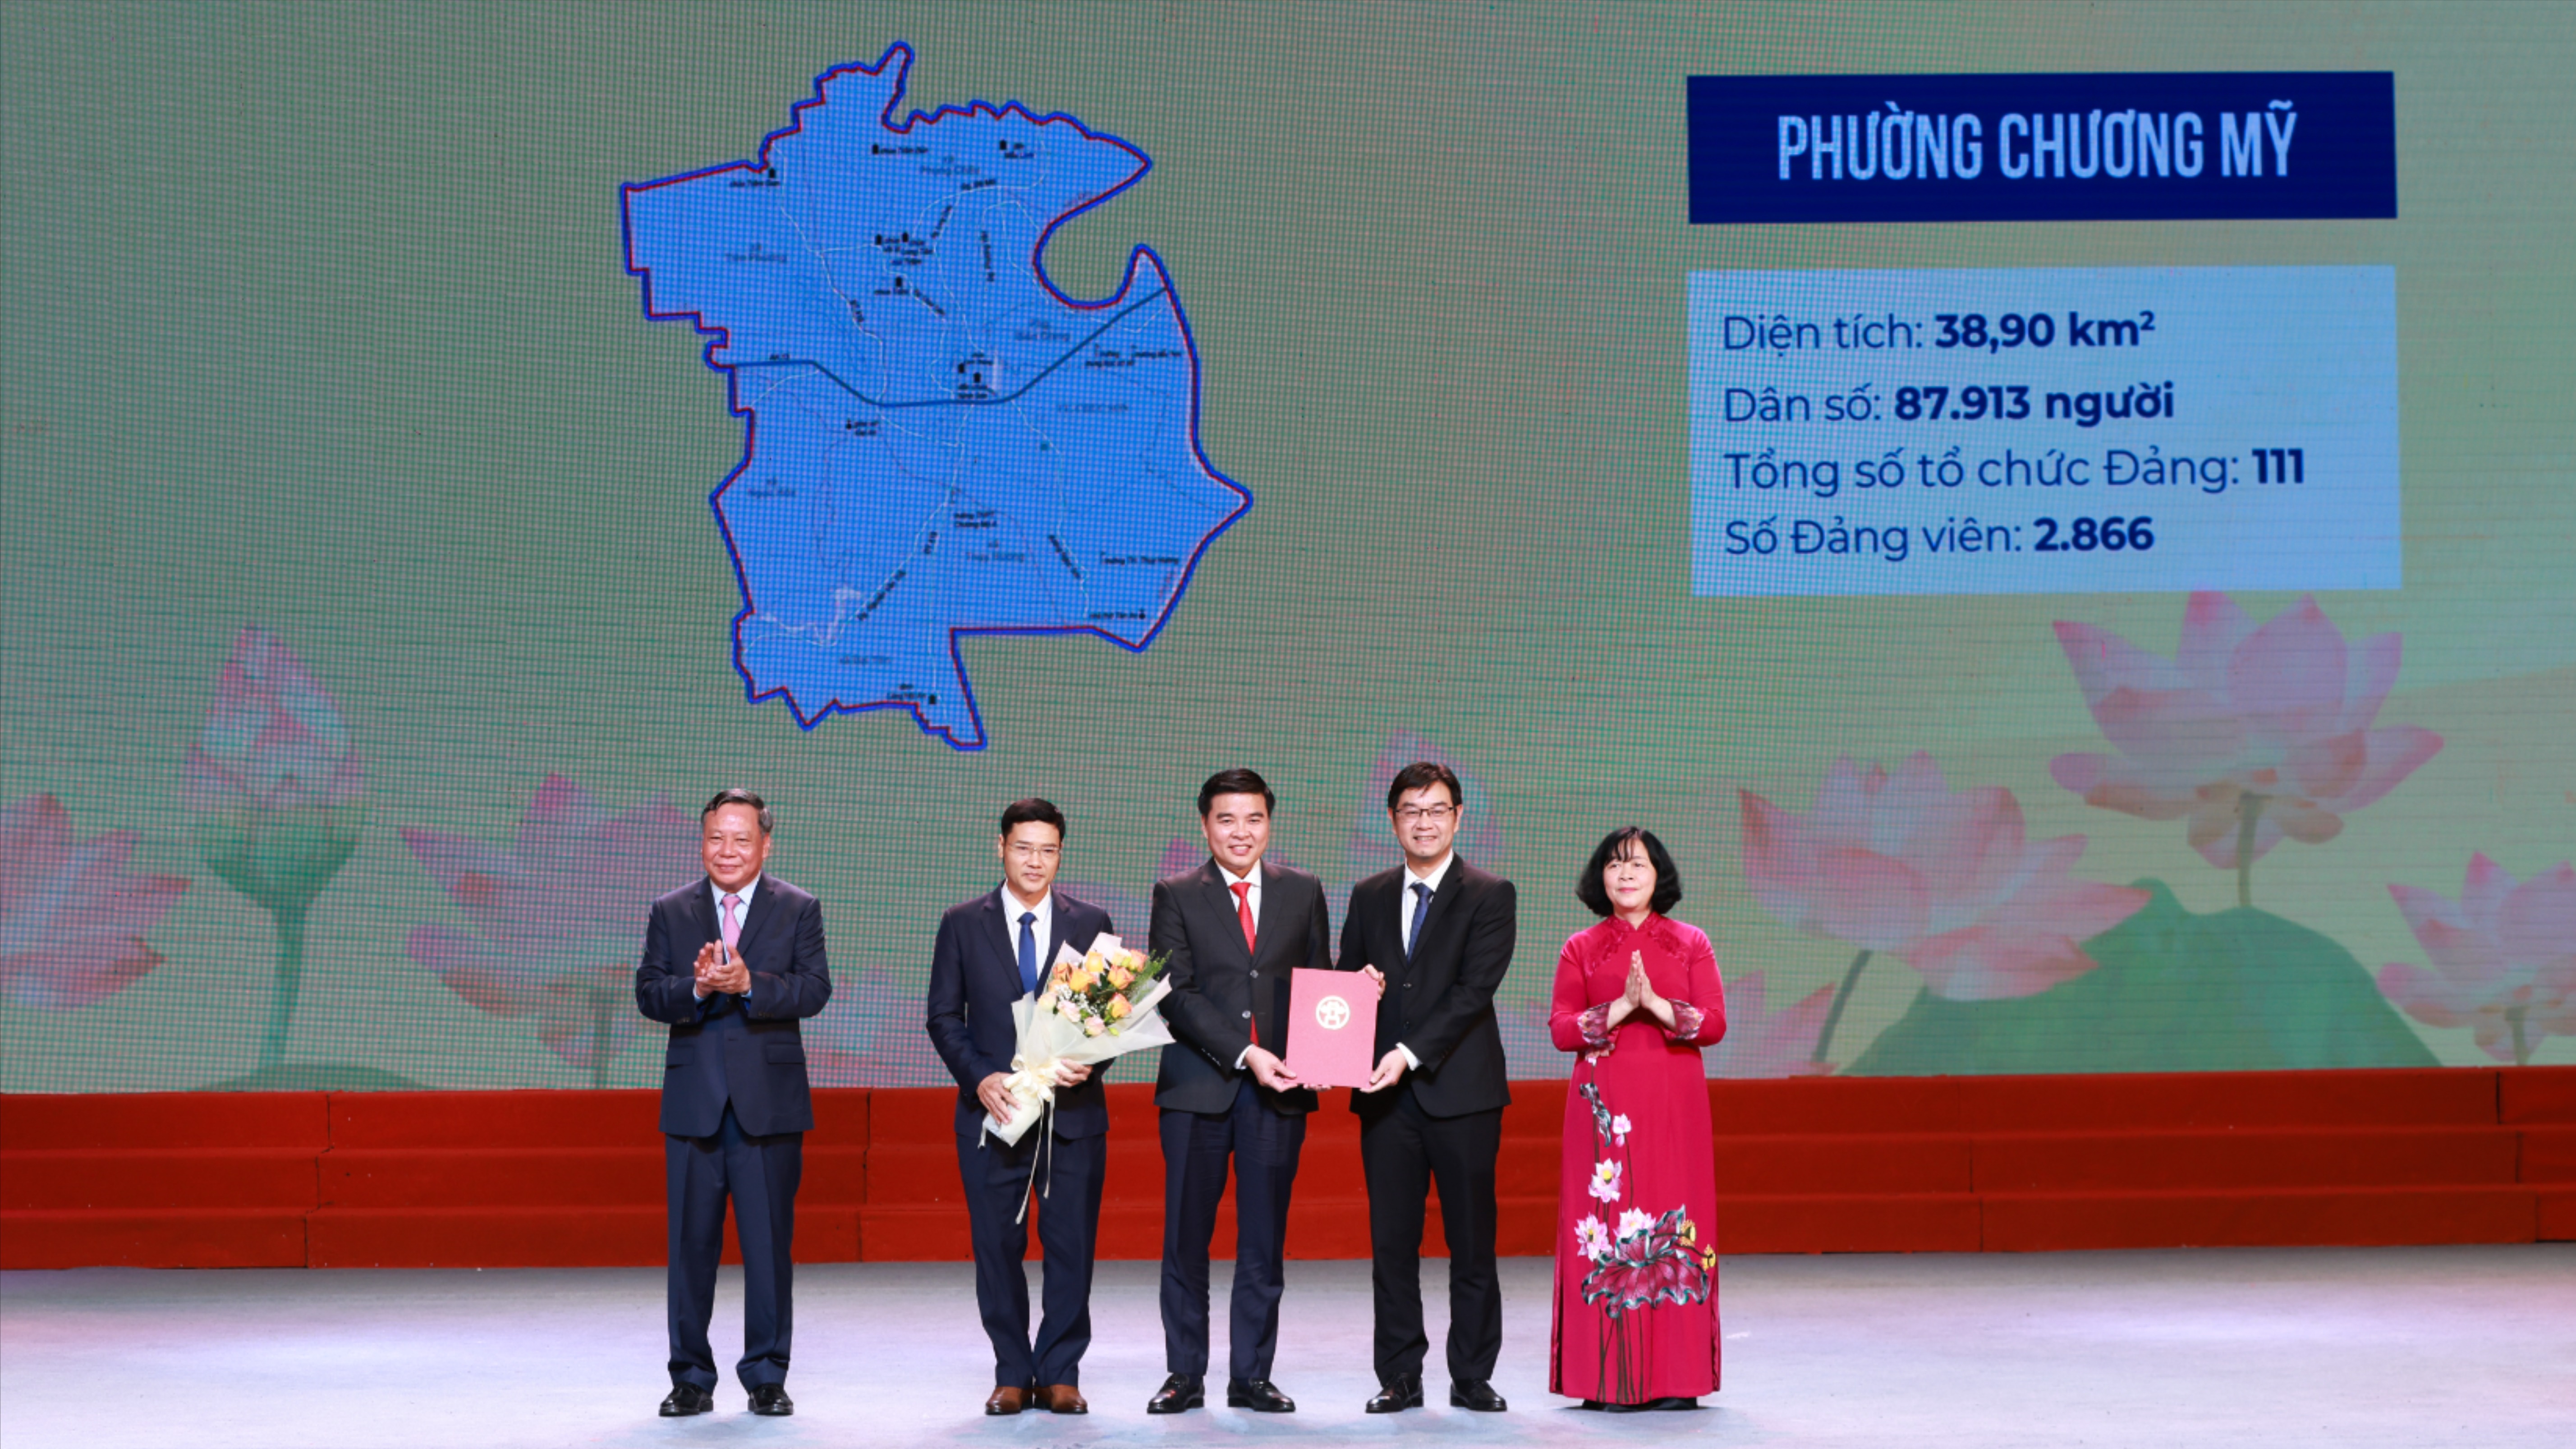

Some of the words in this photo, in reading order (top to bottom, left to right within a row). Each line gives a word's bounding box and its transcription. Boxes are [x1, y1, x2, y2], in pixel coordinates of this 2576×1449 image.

[1777, 101, 1983, 180] PHƯỜNG
[1998, 109, 2204, 179] CHƯƠNG
[2220, 99, 2296, 176] MỸ
[1723, 314, 1820, 357] Diện
[1833, 314, 1922, 350] tích:
[1934, 312, 2056, 354] 38,90
[1724, 386, 1810, 422] Dân
[1825, 383, 1880, 421] số:
[1894, 384, 2031, 421] 87.913
[2045, 381, 2174, 429] người
[1723, 448, 1839, 498] Tổng
[1855, 448, 1905, 488] số
[1918, 446, 1965, 488] tổ
[1977, 449, 2089, 487] chức
[2103, 446, 2238, 494] Đảng:
[2251, 447, 2304, 485] 111
[1725, 517, 1778, 555] Số
[1790, 516, 1909, 562] Đảng
[1922, 517, 2020, 552] viên:
[2033, 515, 2155, 552] 2.866
